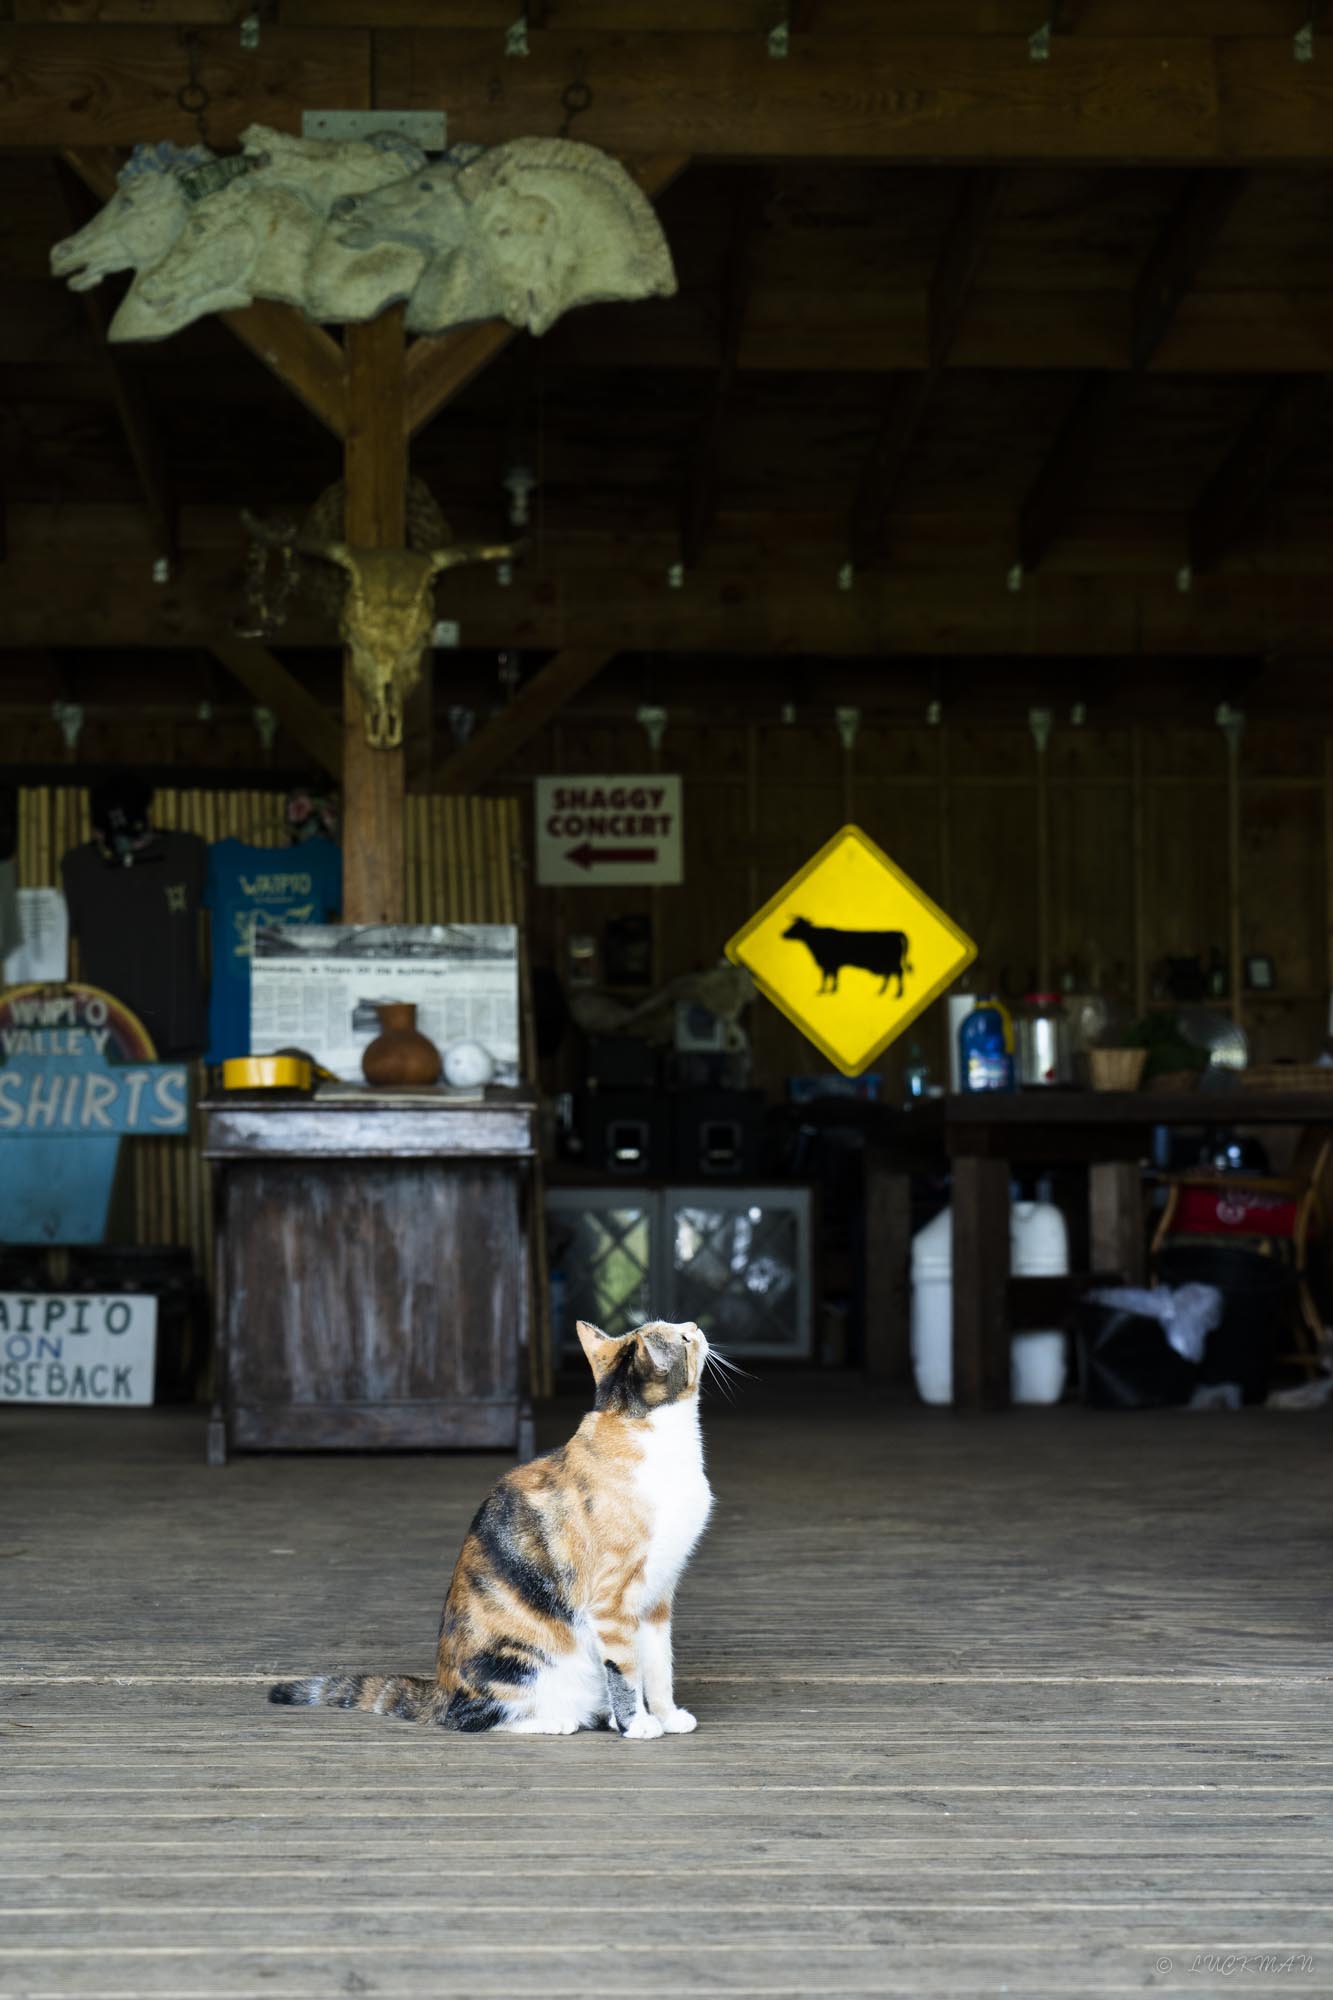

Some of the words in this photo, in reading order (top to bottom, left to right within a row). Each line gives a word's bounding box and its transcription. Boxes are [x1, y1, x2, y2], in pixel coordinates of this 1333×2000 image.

[553, 787, 665, 811] SHAGGY
[547, 813, 672, 838] CONCERT
[1, 1028, 111, 1056] VALLEY
[5, 1334, 62, 1361] ON
